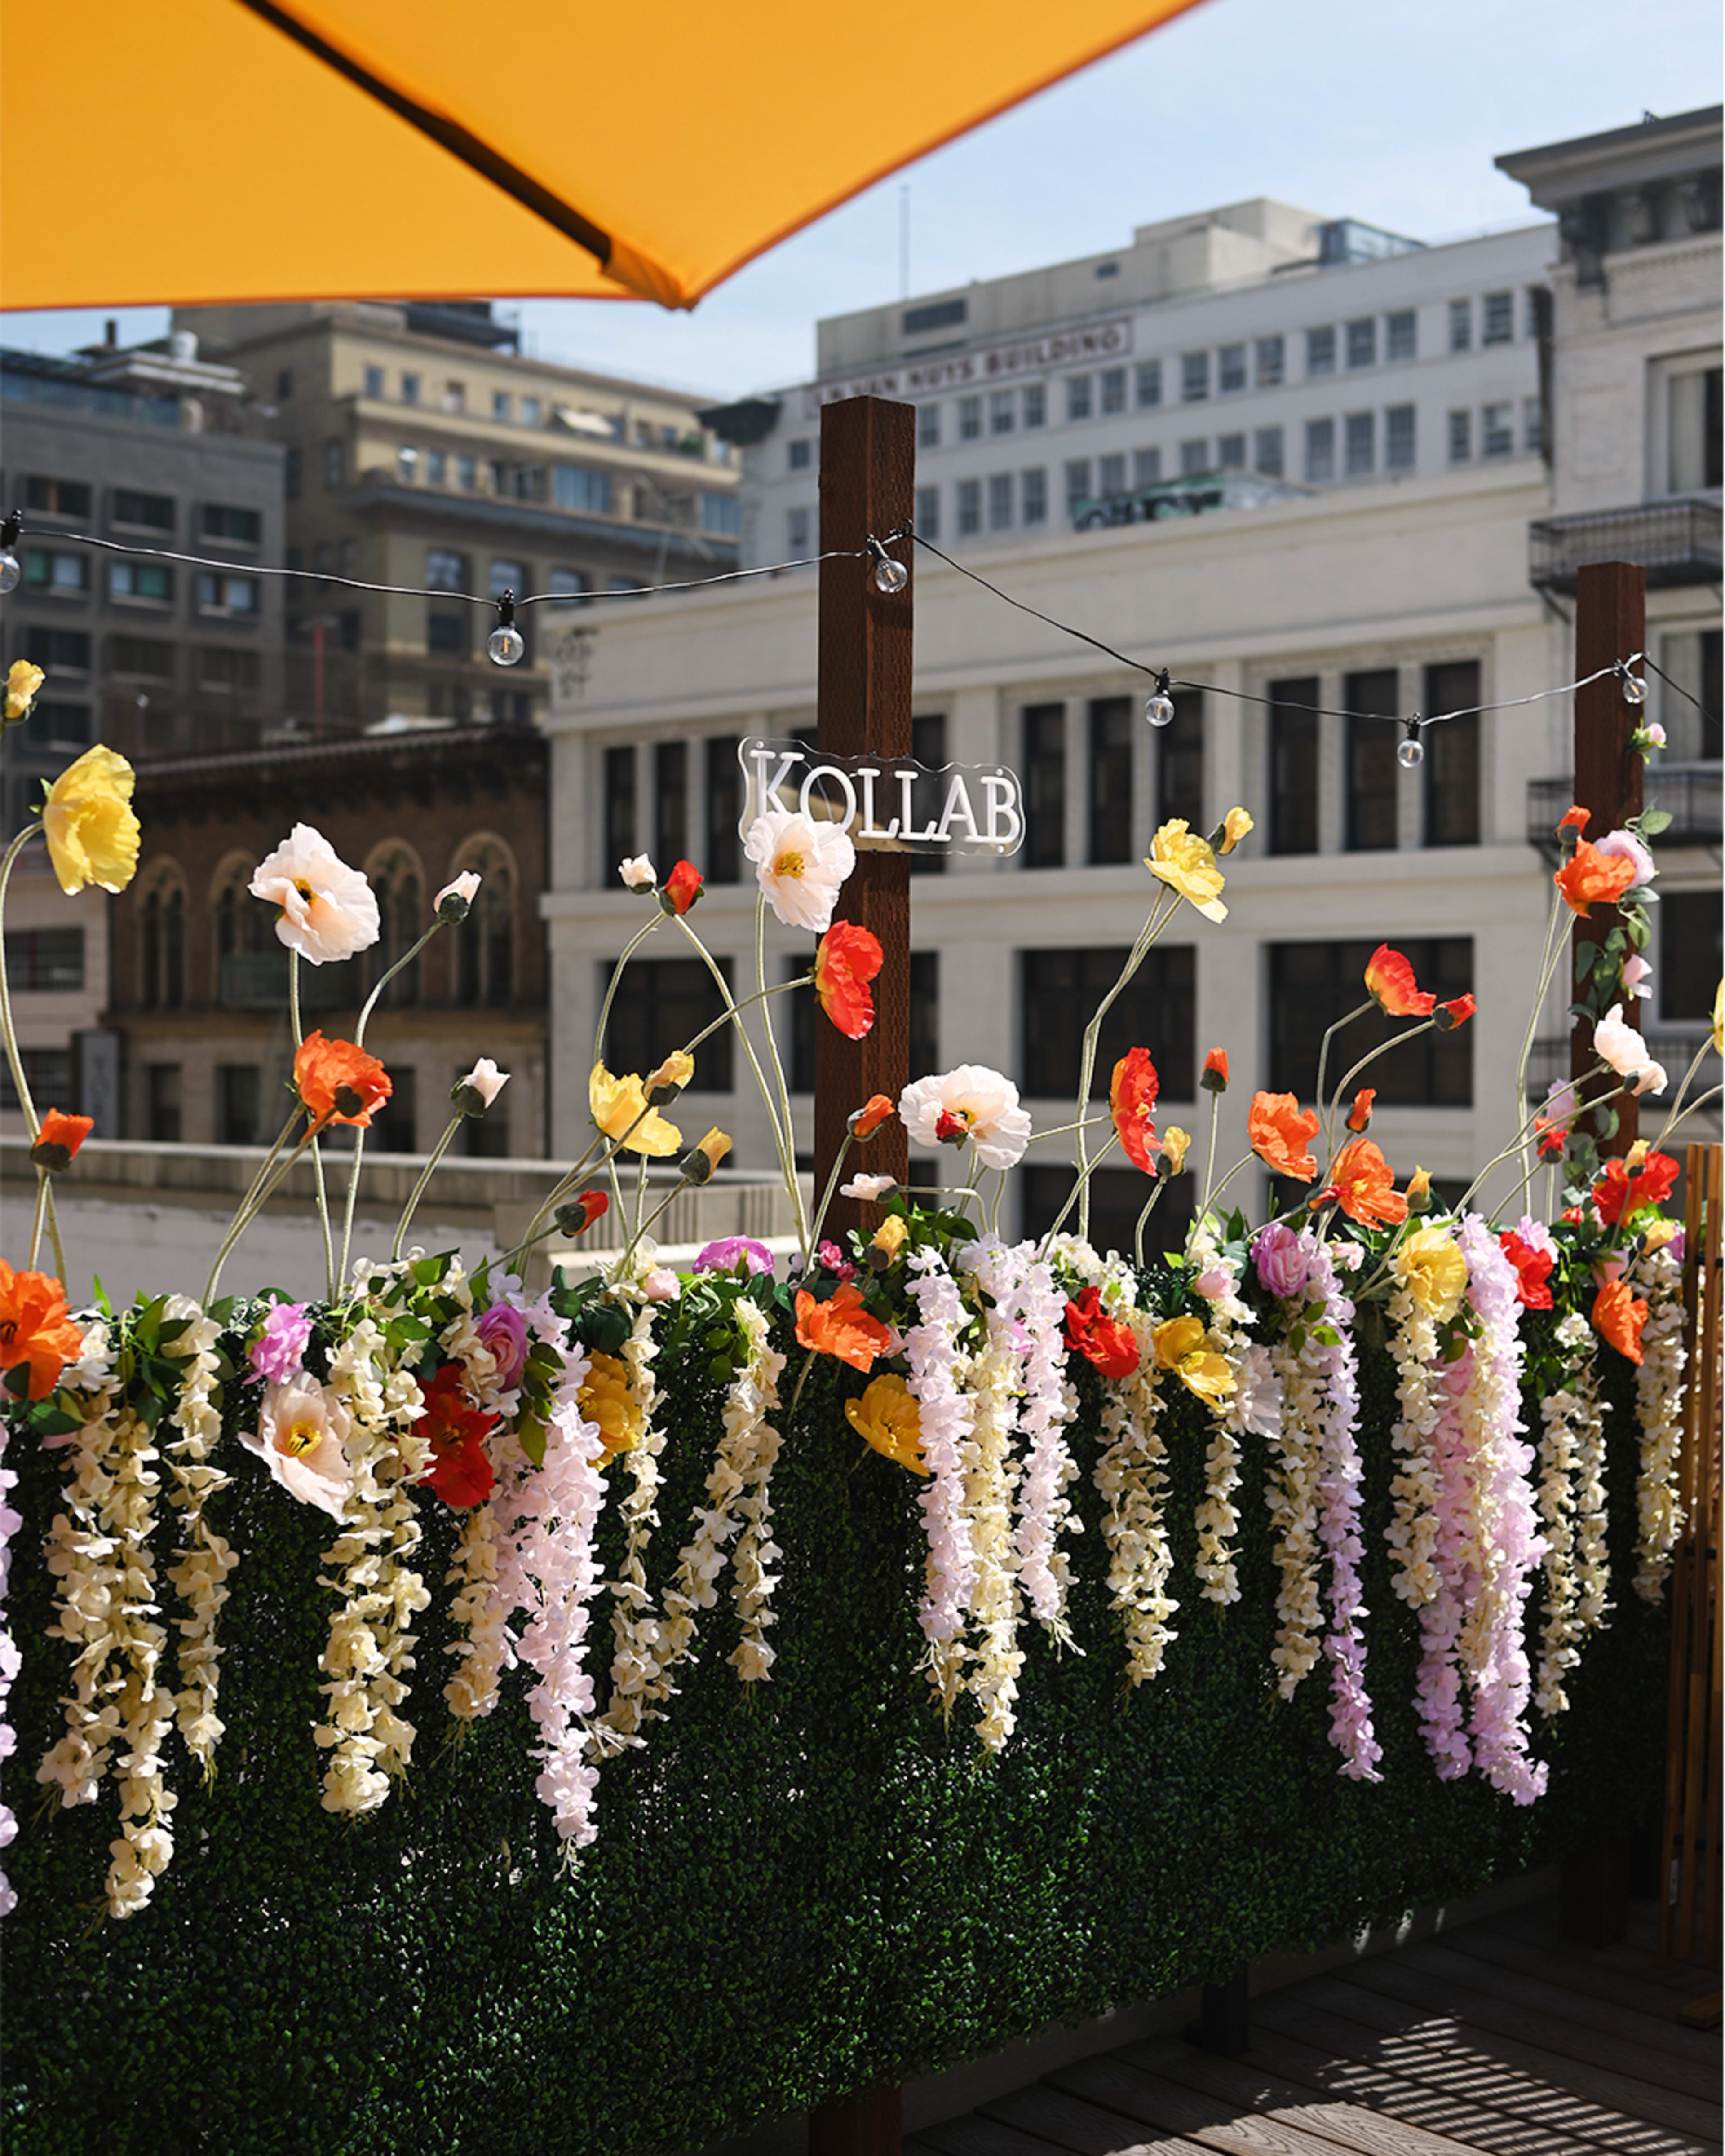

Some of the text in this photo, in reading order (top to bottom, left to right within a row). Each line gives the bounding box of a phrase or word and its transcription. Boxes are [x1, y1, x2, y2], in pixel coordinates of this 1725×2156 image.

[908, 358, 975, 388] NUYS
[986, 327, 1120, 374] BUILDING
[750, 750, 1021, 843] KOLLAB
